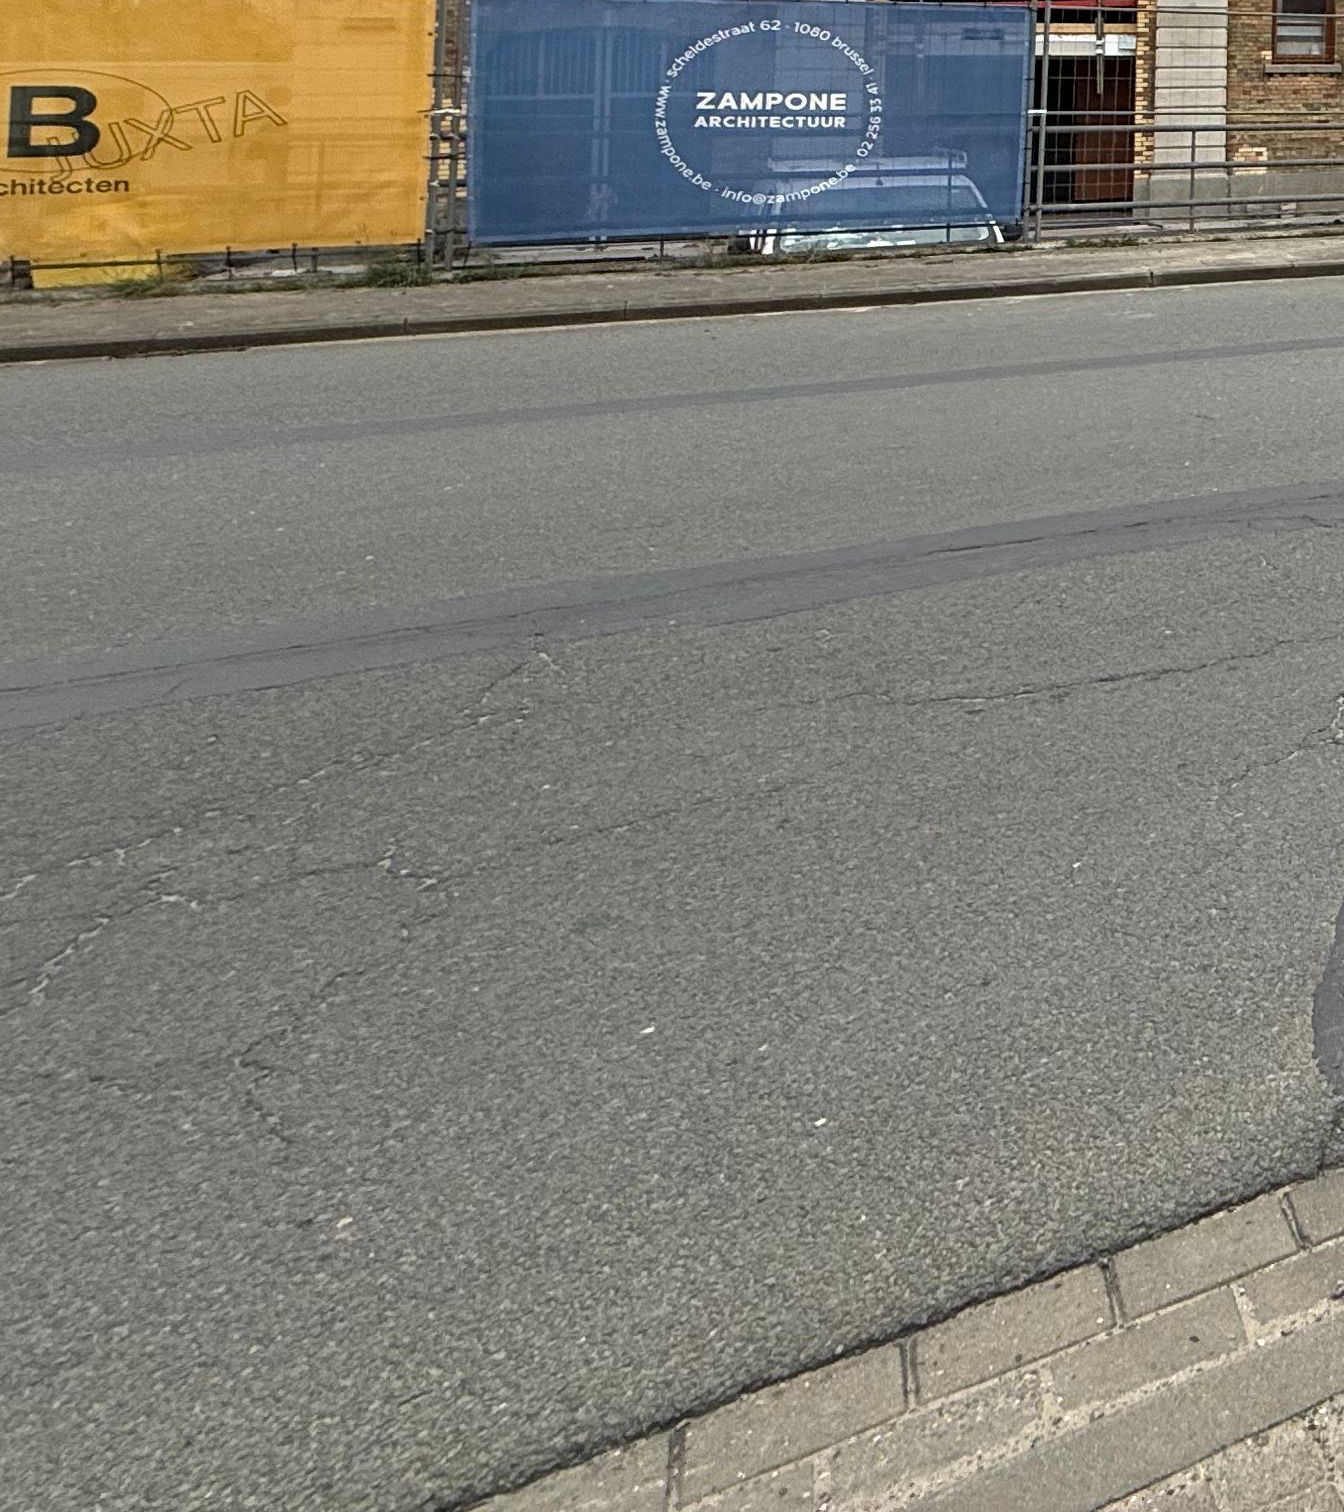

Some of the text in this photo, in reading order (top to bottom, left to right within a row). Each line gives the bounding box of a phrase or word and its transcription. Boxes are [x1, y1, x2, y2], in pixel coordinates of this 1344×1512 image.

[666, 20, 875, 78] scheldestraat 62 1080 brussel
[7, 85, 101, 158] B
[693, 115, 846, 128] ARCHITECTUUR
[695, 91, 848, 111] ZAMPONE
[857, 83, 883, 158] 02 256 33 41
[47, 89, 289, 182] JUXTA
[655, 85, 713, 191] www.zampone.be
[0, 177, 130, 196] chitecten
[721, 163, 857, 205] info@zampone.be
